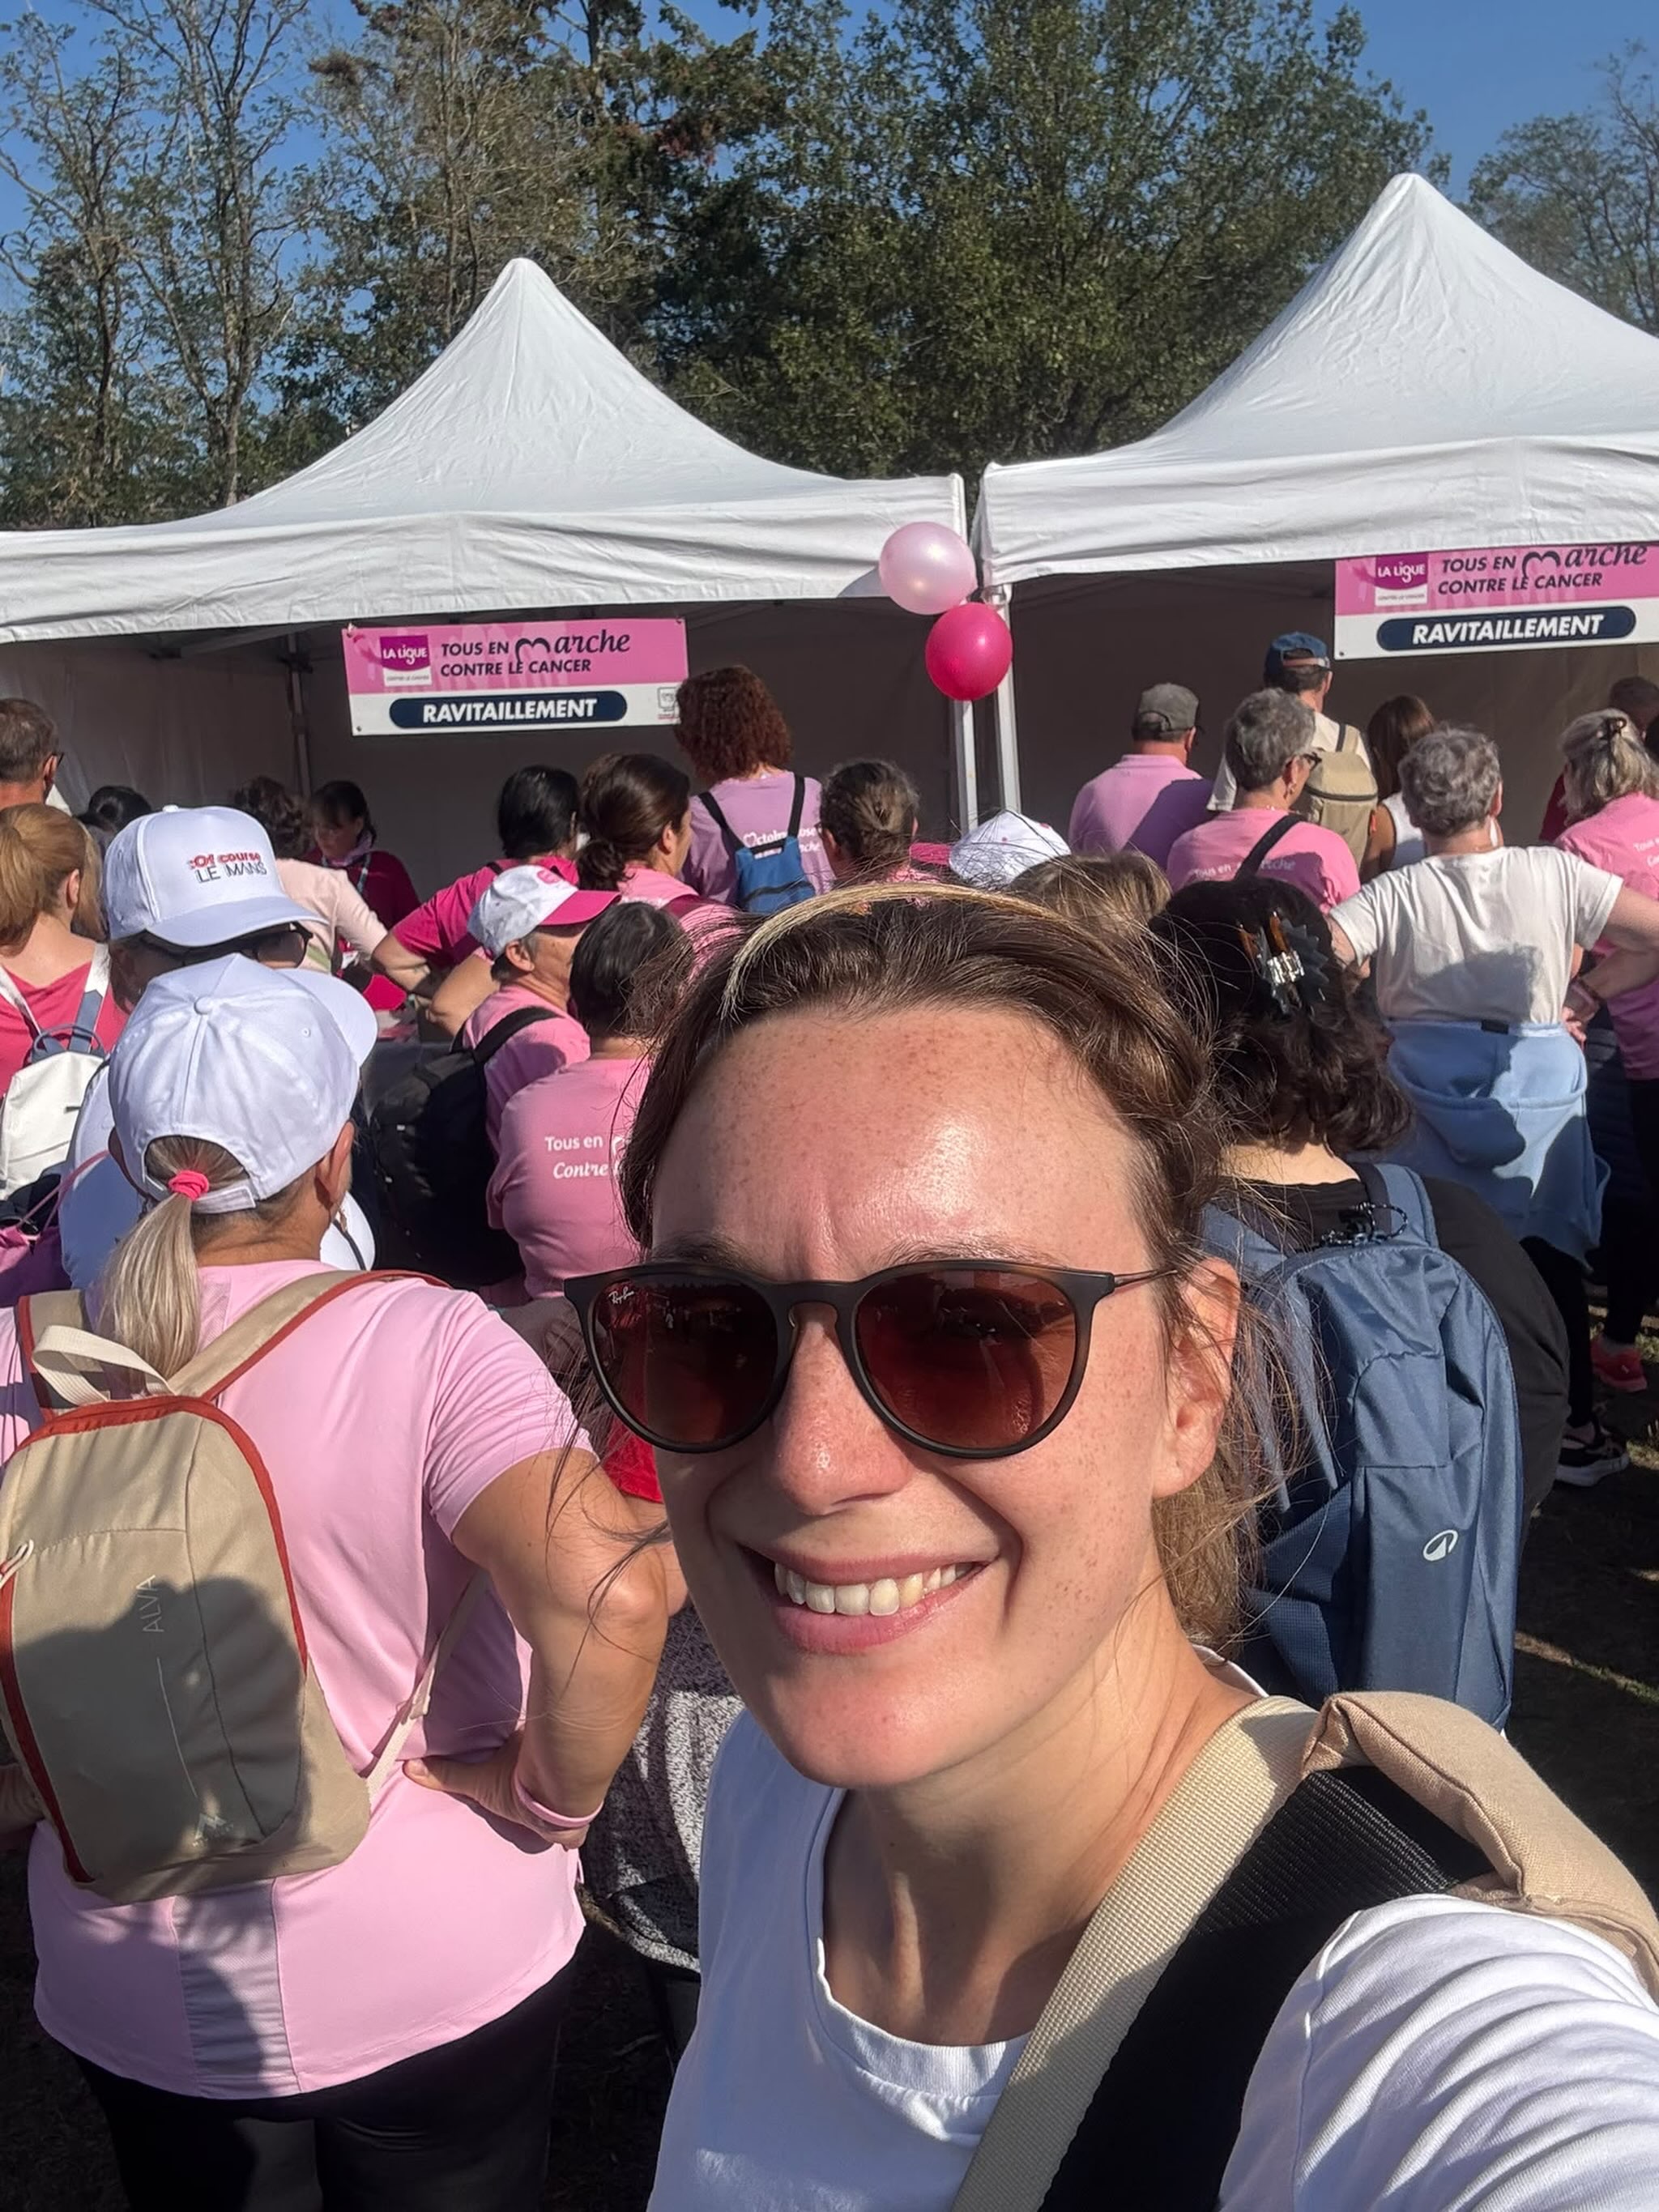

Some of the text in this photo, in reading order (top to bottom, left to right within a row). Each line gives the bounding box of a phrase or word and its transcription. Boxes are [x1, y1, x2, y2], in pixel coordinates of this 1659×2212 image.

[1378, 566, 1392, 577] LA
[1442, 556, 1487, 573] TOUS
[1493, 556, 1516, 570] EN
[1438, 573, 1603, 595] CONTRE LE CANCER
[1412, 614, 1605, 645] RAVITAILLEMENT
[383, 647, 397, 659] LA
[441, 641, 483, 657] TOUS
[488, 641, 510, 654] EN
[441, 659, 591, 677] CONTRE LE CANCER
[423, 698, 598, 723] RAVITAILLEMENT
[195, 861, 267, 883] LE MANS
[544, 1136, 580, 1152] Tous
[583, 1136, 603, 1149] en
[552, 1161, 609, 1179] Contre
[135, 1575, 164, 1632] ALVA
